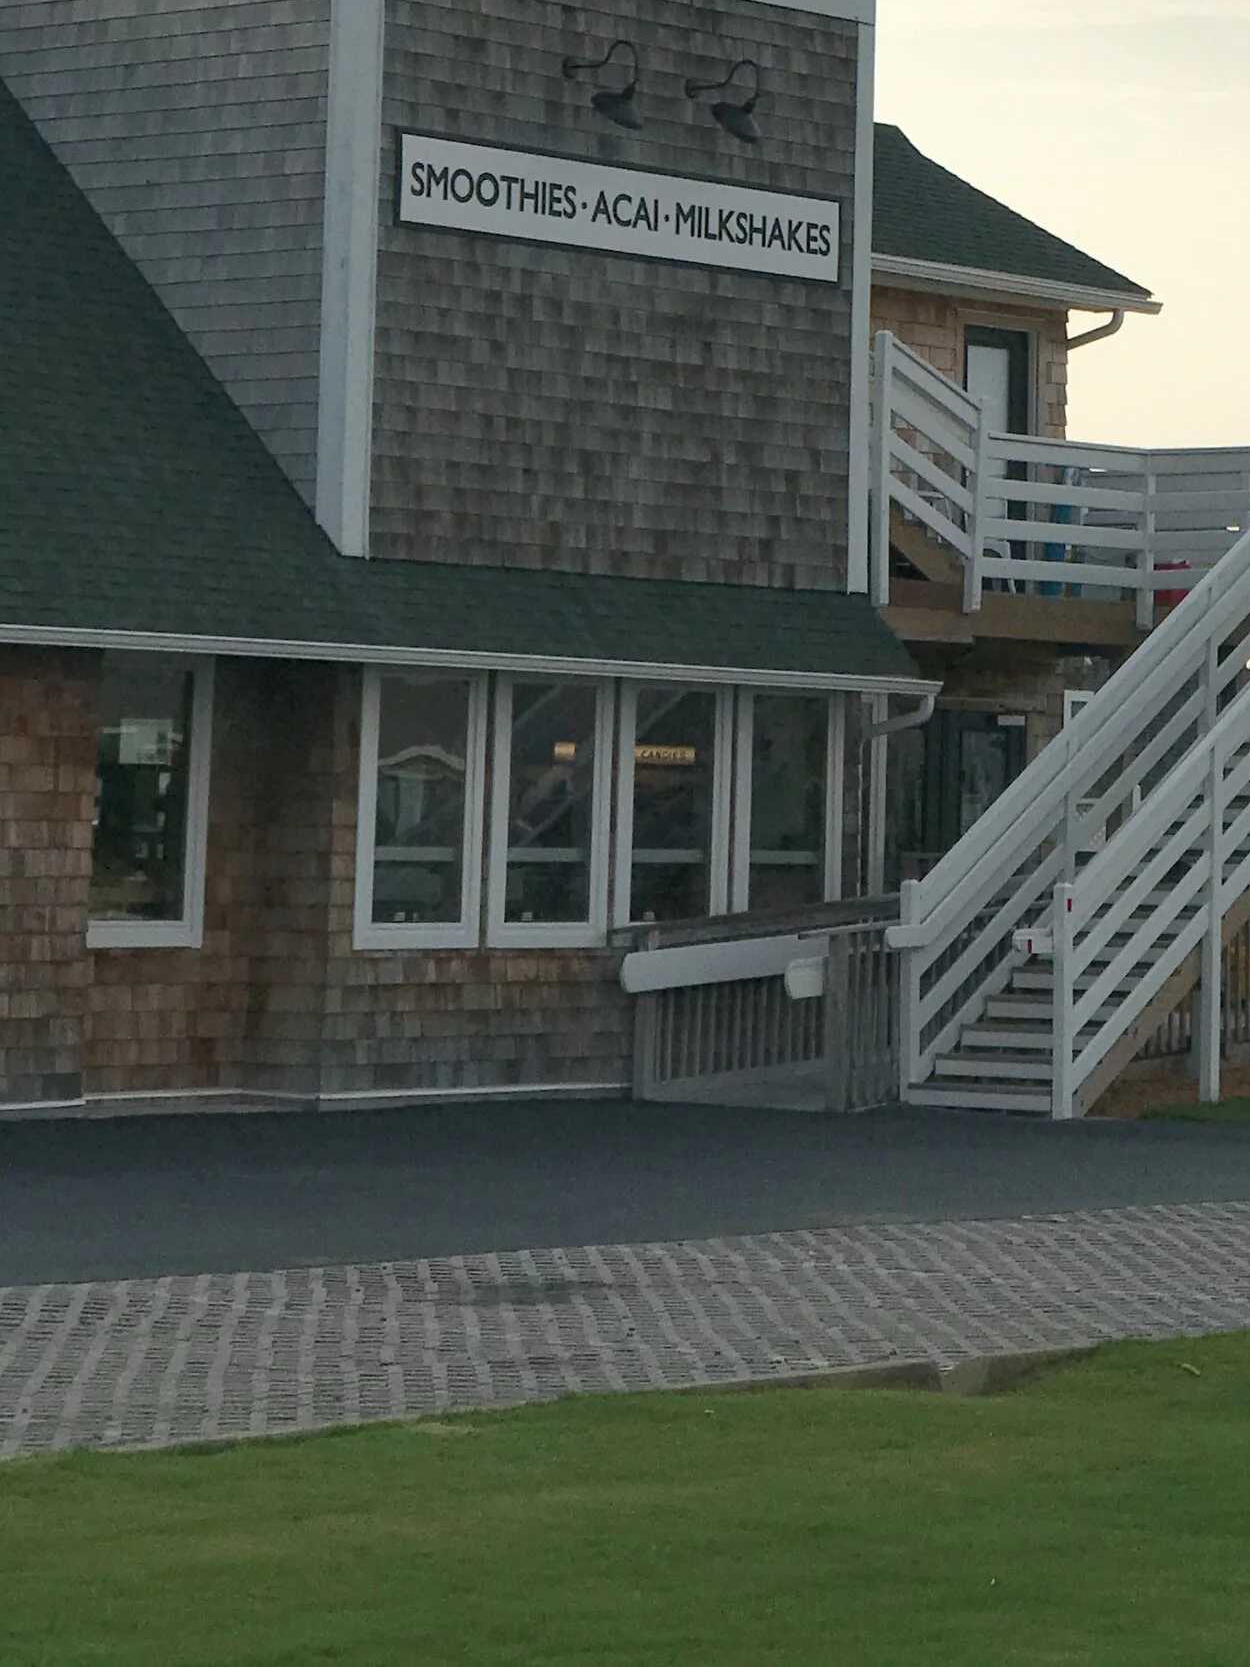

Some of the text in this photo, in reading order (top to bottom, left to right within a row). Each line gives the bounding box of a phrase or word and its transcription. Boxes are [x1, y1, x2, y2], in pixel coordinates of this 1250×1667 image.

[410, 162, 831, 257] SMOOTHIES ACAI MILKSHAKES
